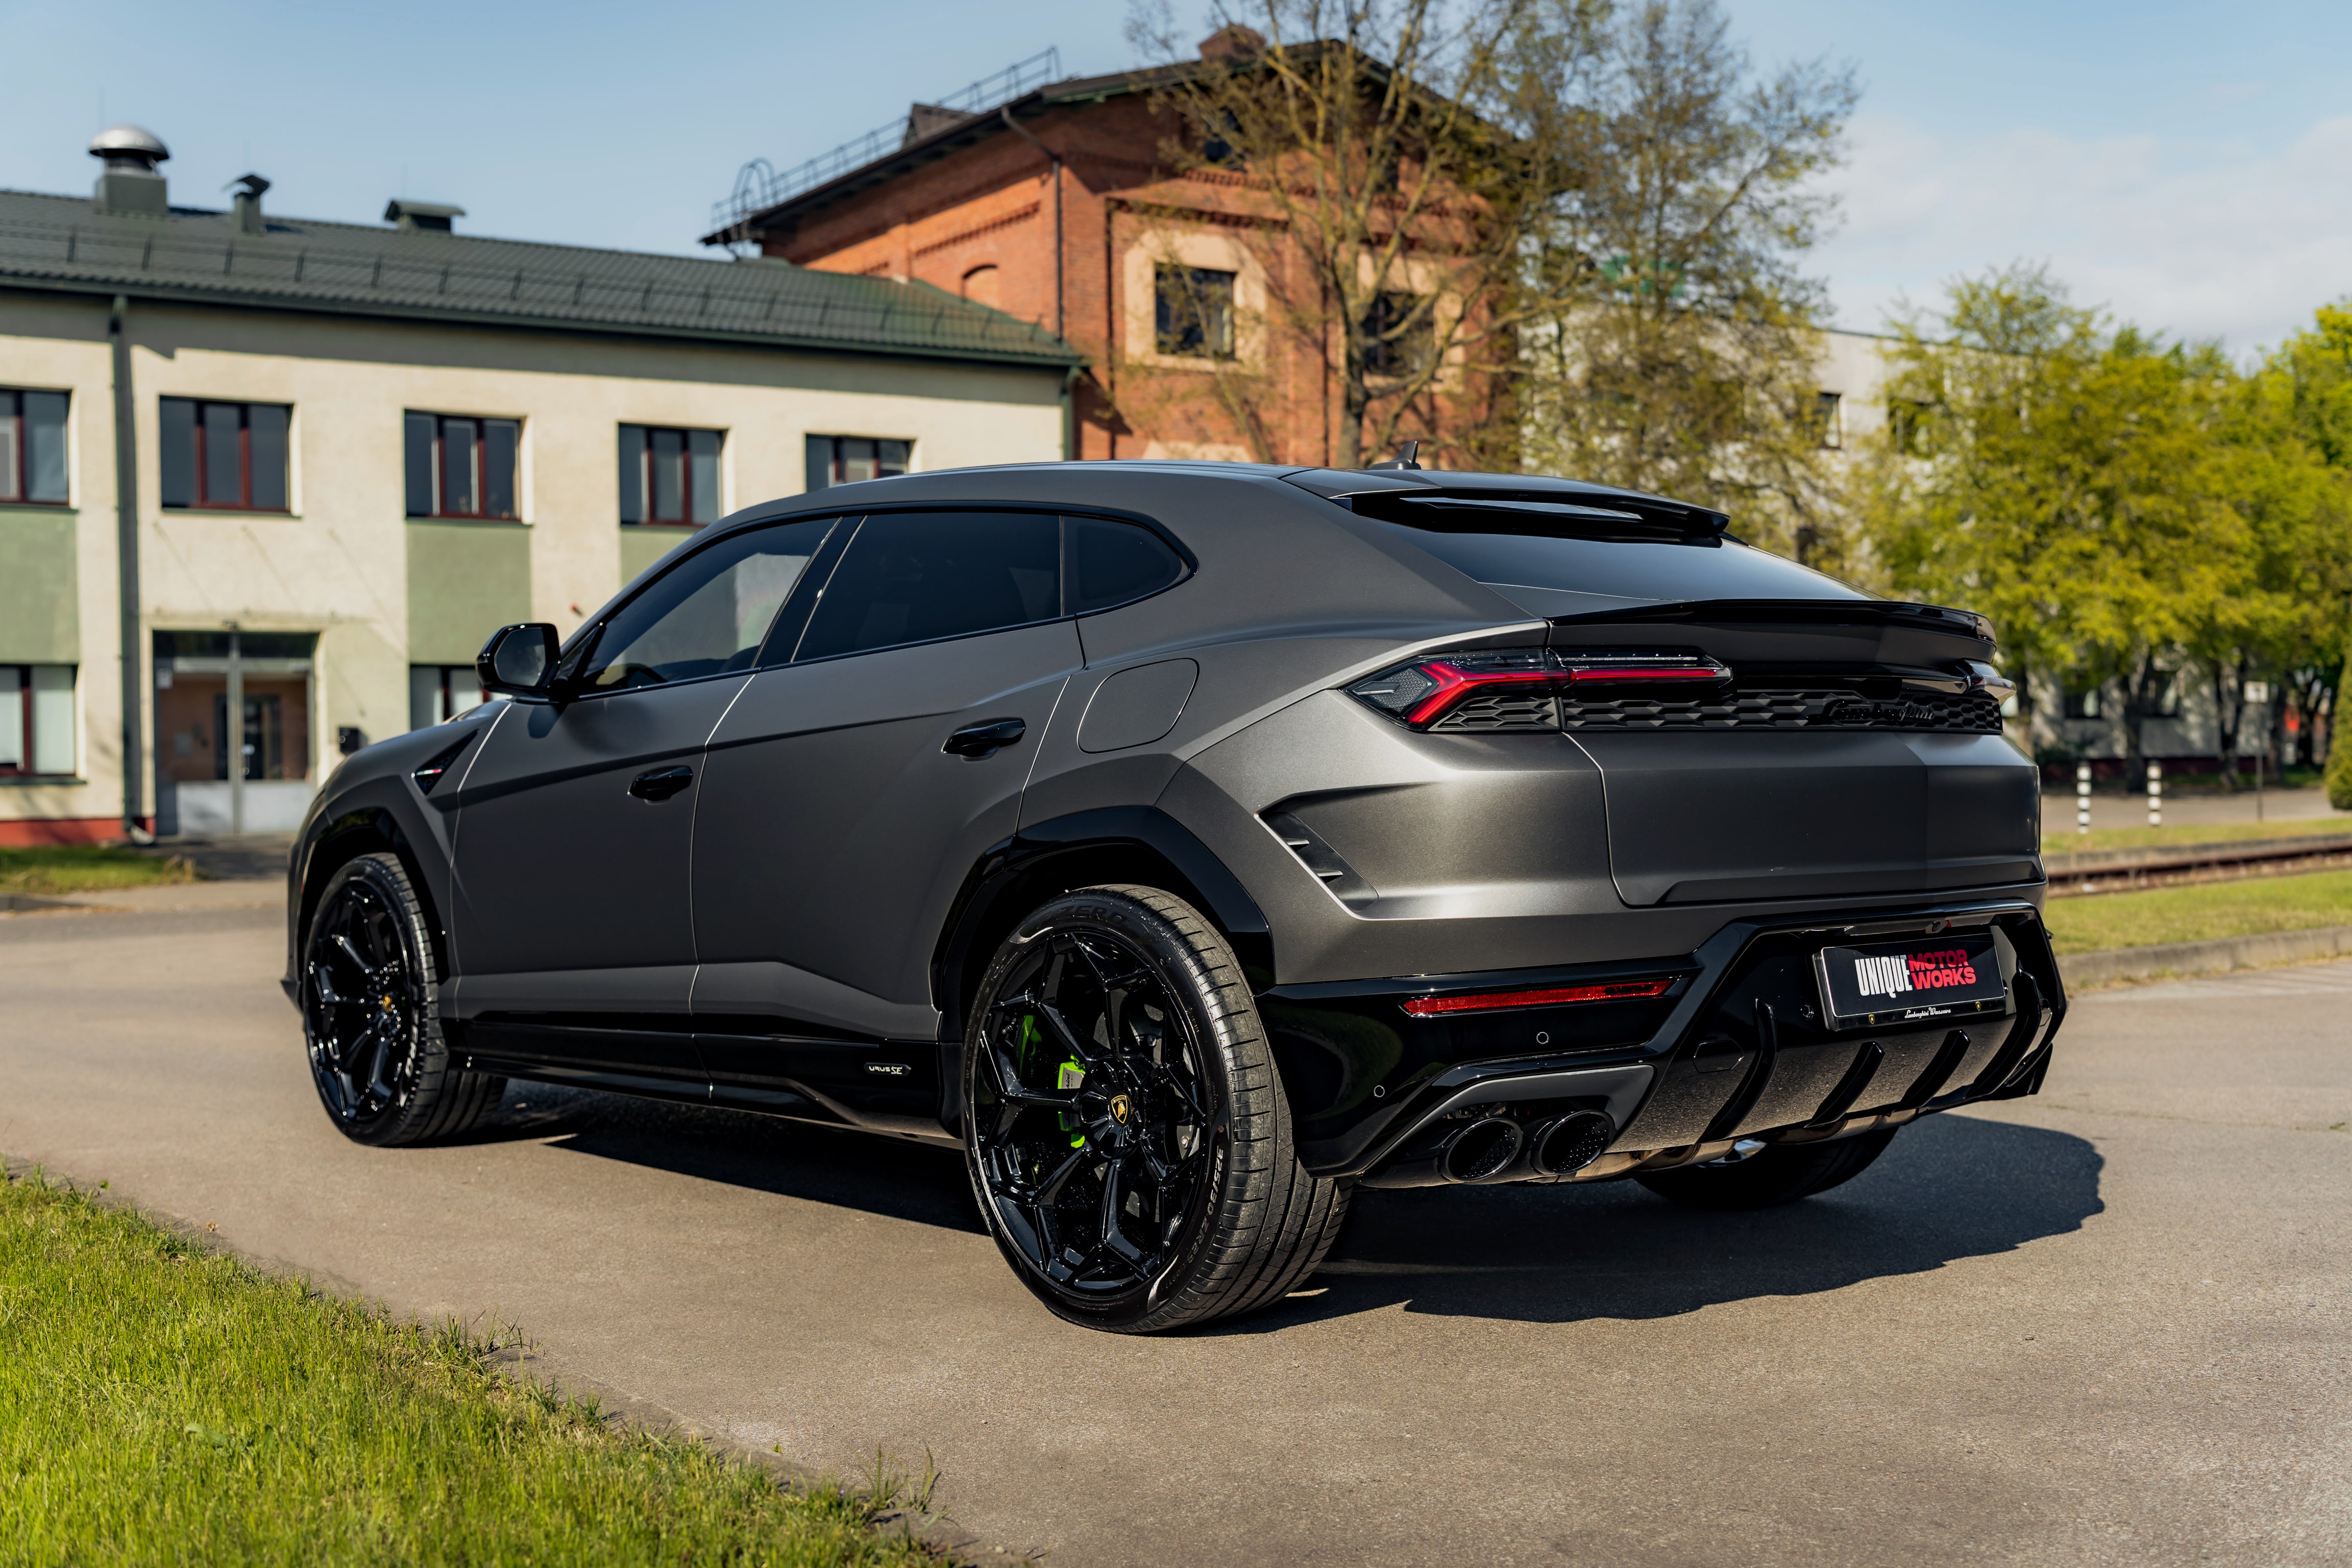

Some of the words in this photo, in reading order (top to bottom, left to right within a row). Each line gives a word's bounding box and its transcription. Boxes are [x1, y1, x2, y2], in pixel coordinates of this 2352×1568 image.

[1908, 949, 1969, 972] MOTOR
[1855, 955, 1913, 998] UNIQUE
[1910, 966, 1976, 990] WORKS
[1904, 1009, 1929, 1019] Lamborghini
